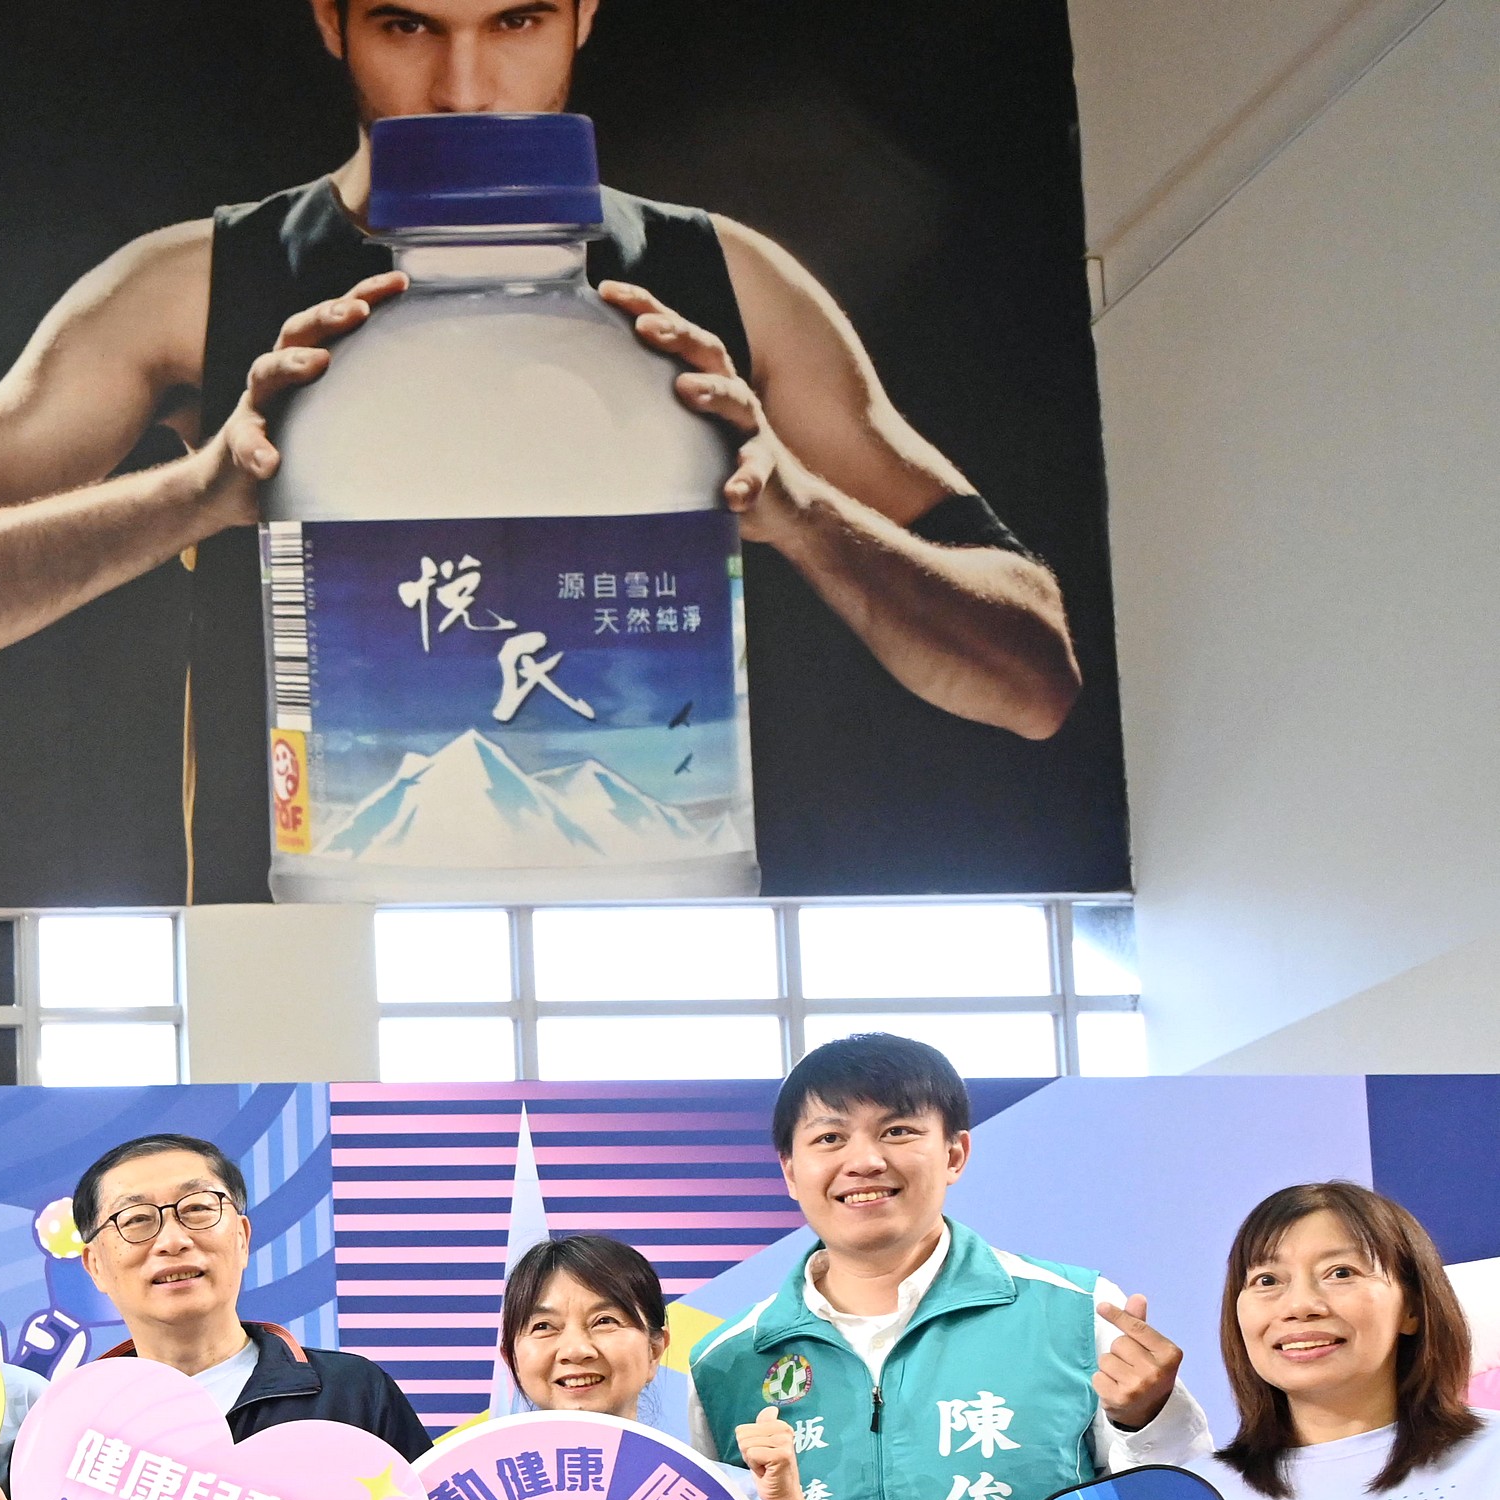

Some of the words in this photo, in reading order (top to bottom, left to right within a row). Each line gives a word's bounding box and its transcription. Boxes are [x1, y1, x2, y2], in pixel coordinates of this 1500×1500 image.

[557, 571, 678, 600] 源自雪山
[594, 604, 701, 635] 天然純淨
